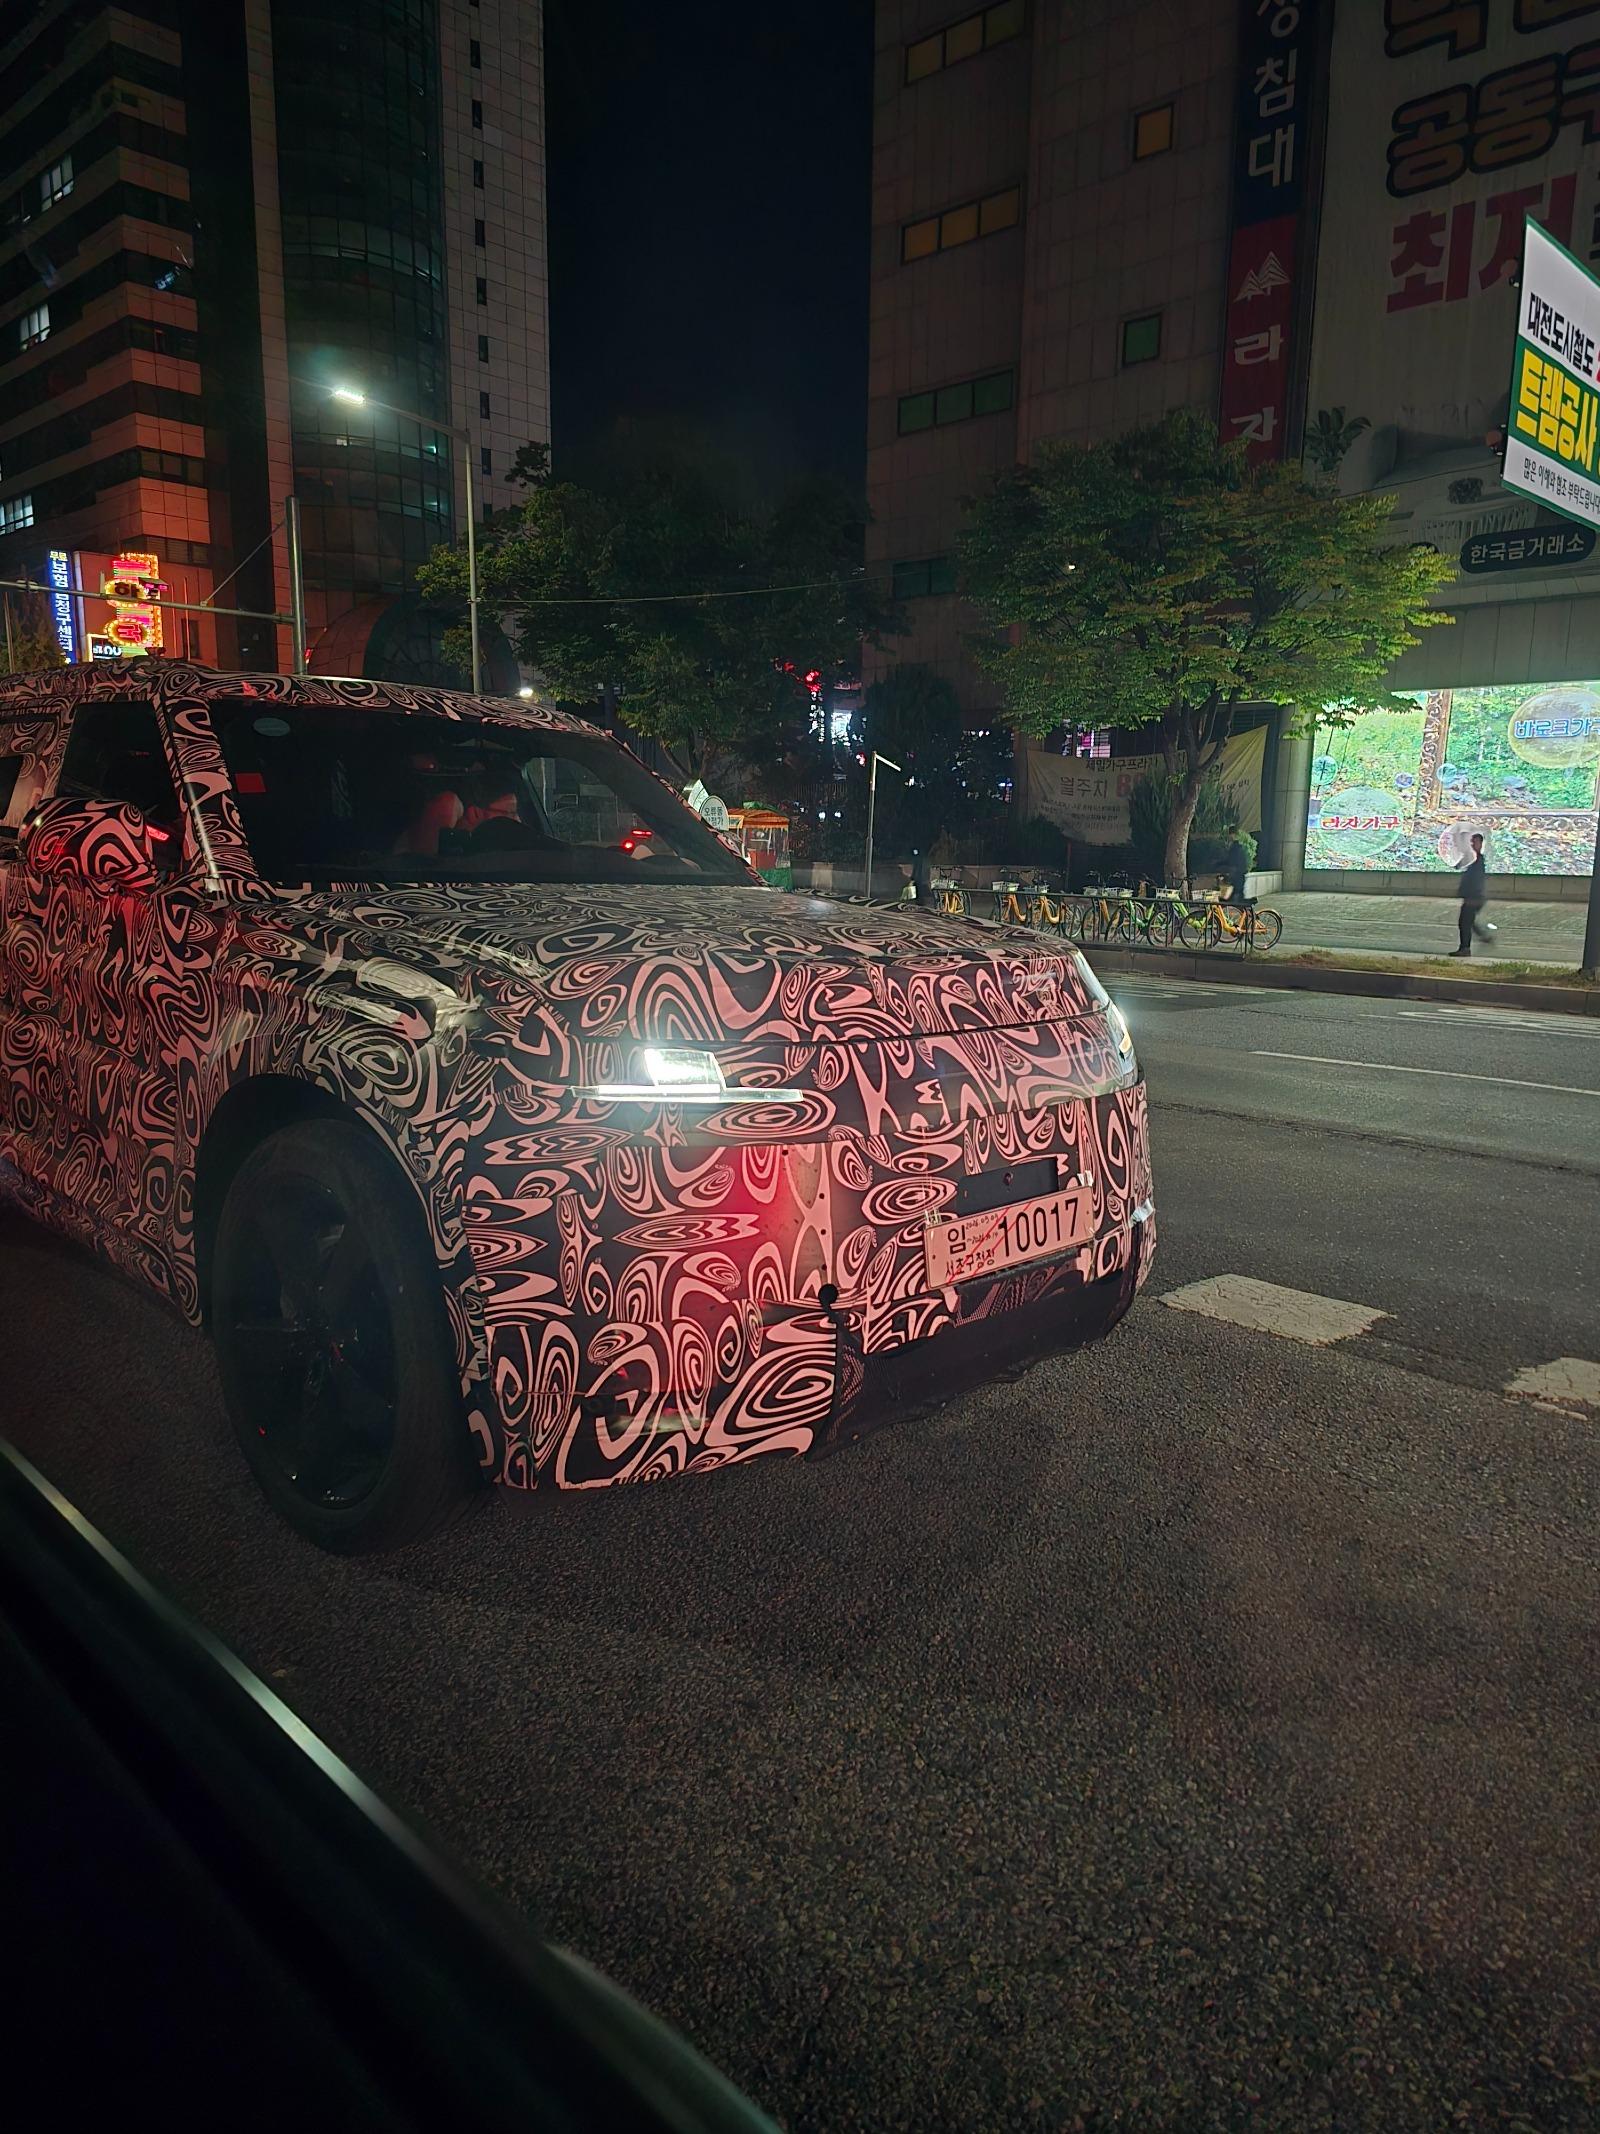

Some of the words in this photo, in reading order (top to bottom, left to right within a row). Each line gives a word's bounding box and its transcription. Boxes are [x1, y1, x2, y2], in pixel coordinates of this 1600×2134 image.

[1526, 292, 1595, 377] 대전도시철도
[1515, 347, 1598, 473] 트램공사
[1523, 457, 1537, 483] 많은
[1470, 532, 1584, 565] 한국금거래소
[1321, 815, 1400, 831] 라자가구
[948, 1224, 967, 1255] 임
[997, 1197, 1079, 1258] 10017
[945, 1247, 996, 1278] 서초구청장
